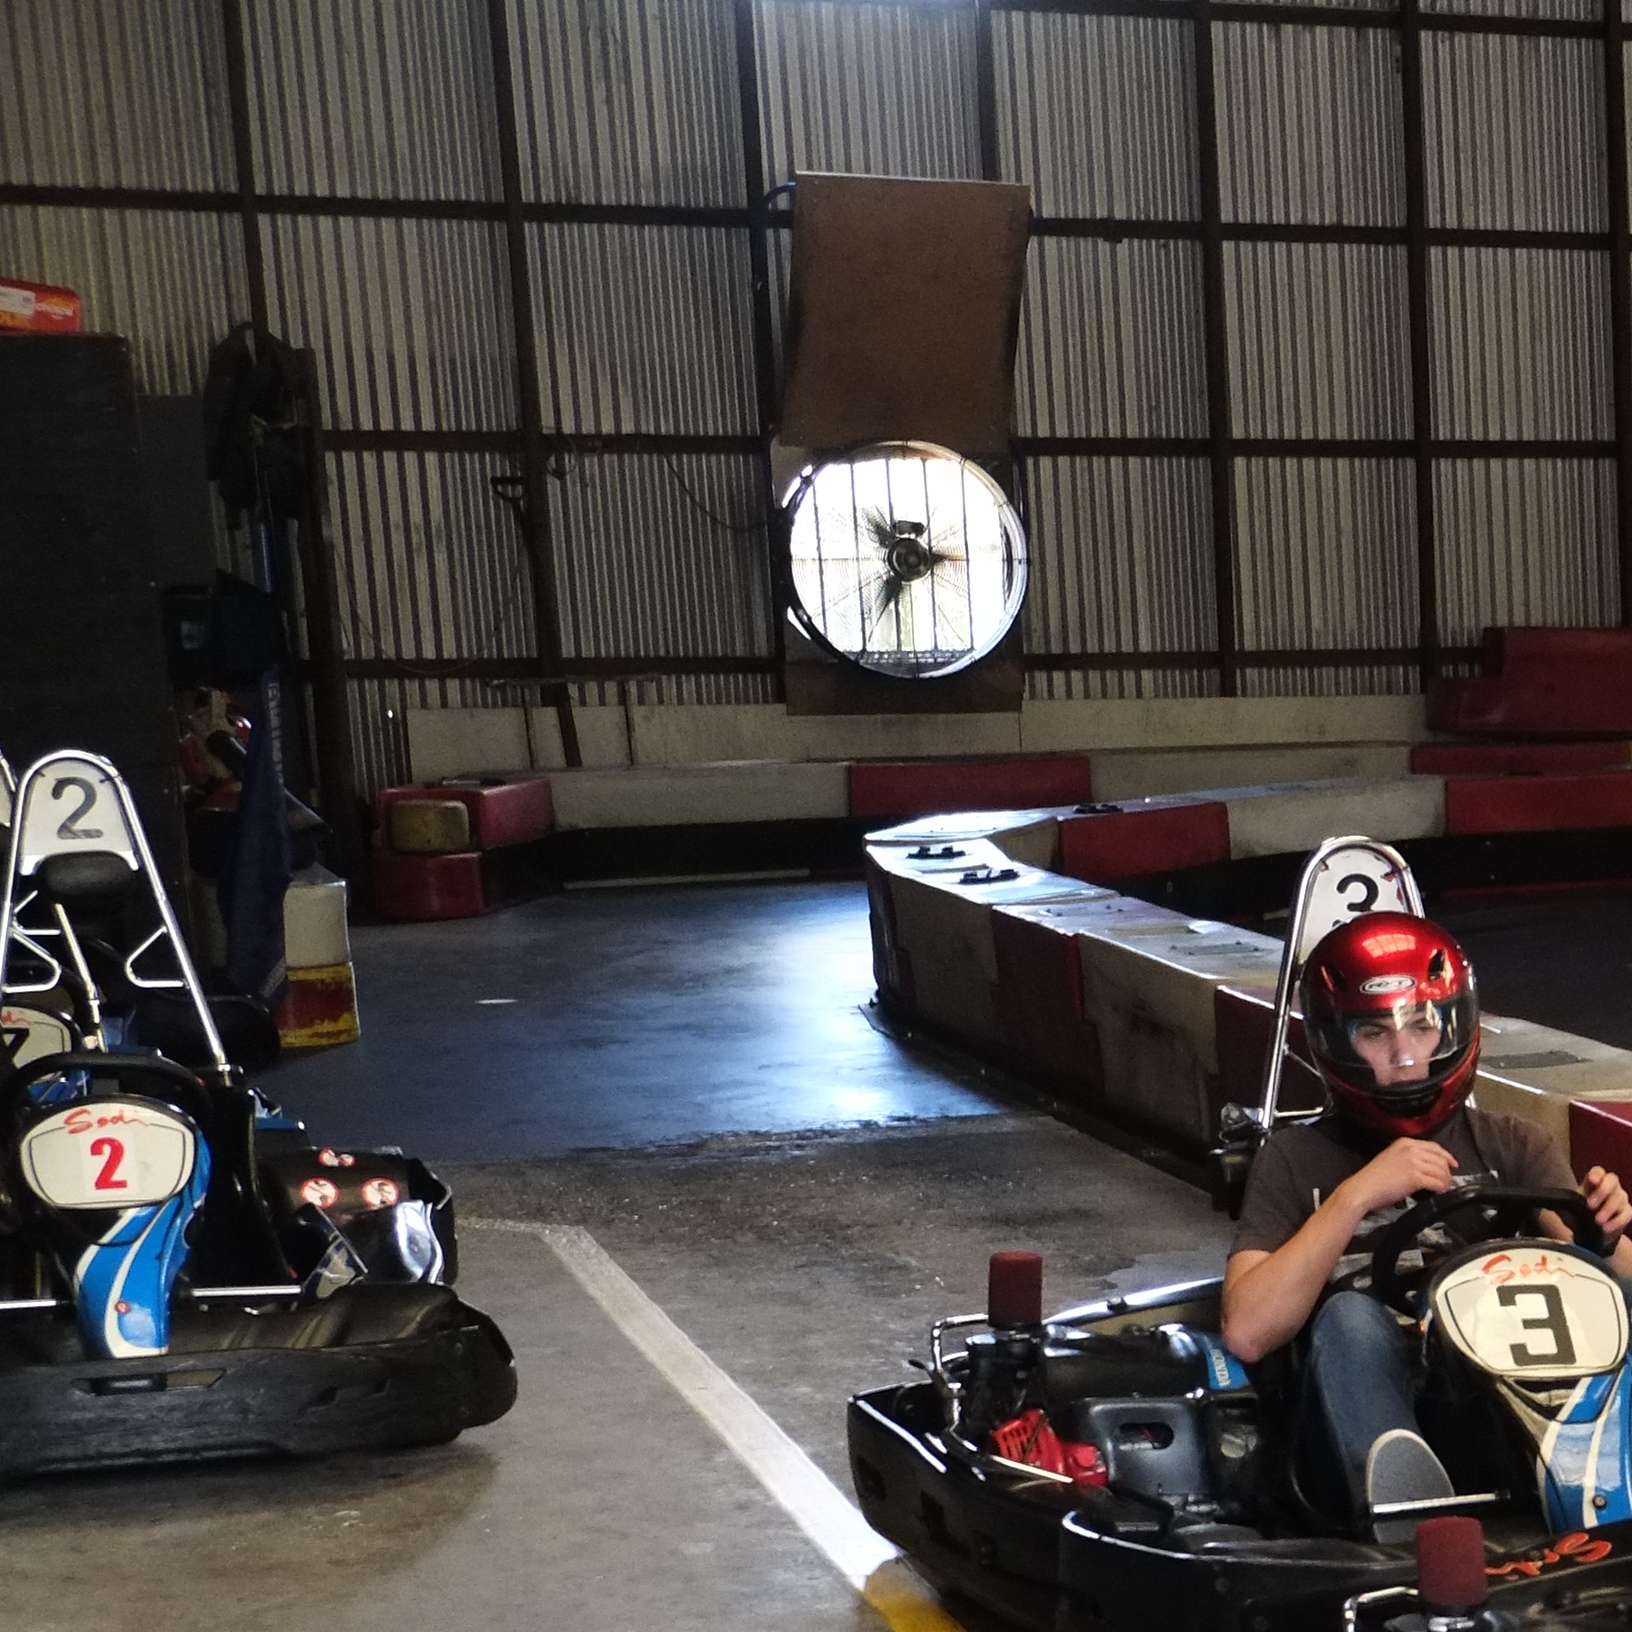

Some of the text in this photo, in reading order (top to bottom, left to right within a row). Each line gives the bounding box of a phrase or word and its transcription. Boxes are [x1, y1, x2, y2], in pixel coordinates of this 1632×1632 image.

[51, 776, 104, 840] 2
[63, 1107, 150, 1135] Sodi
[90, 1136, 128, 1190] 2
[1481, 1253, 1576, 1285] Sodi
[1496, 1284, 1577, 1366] 3
